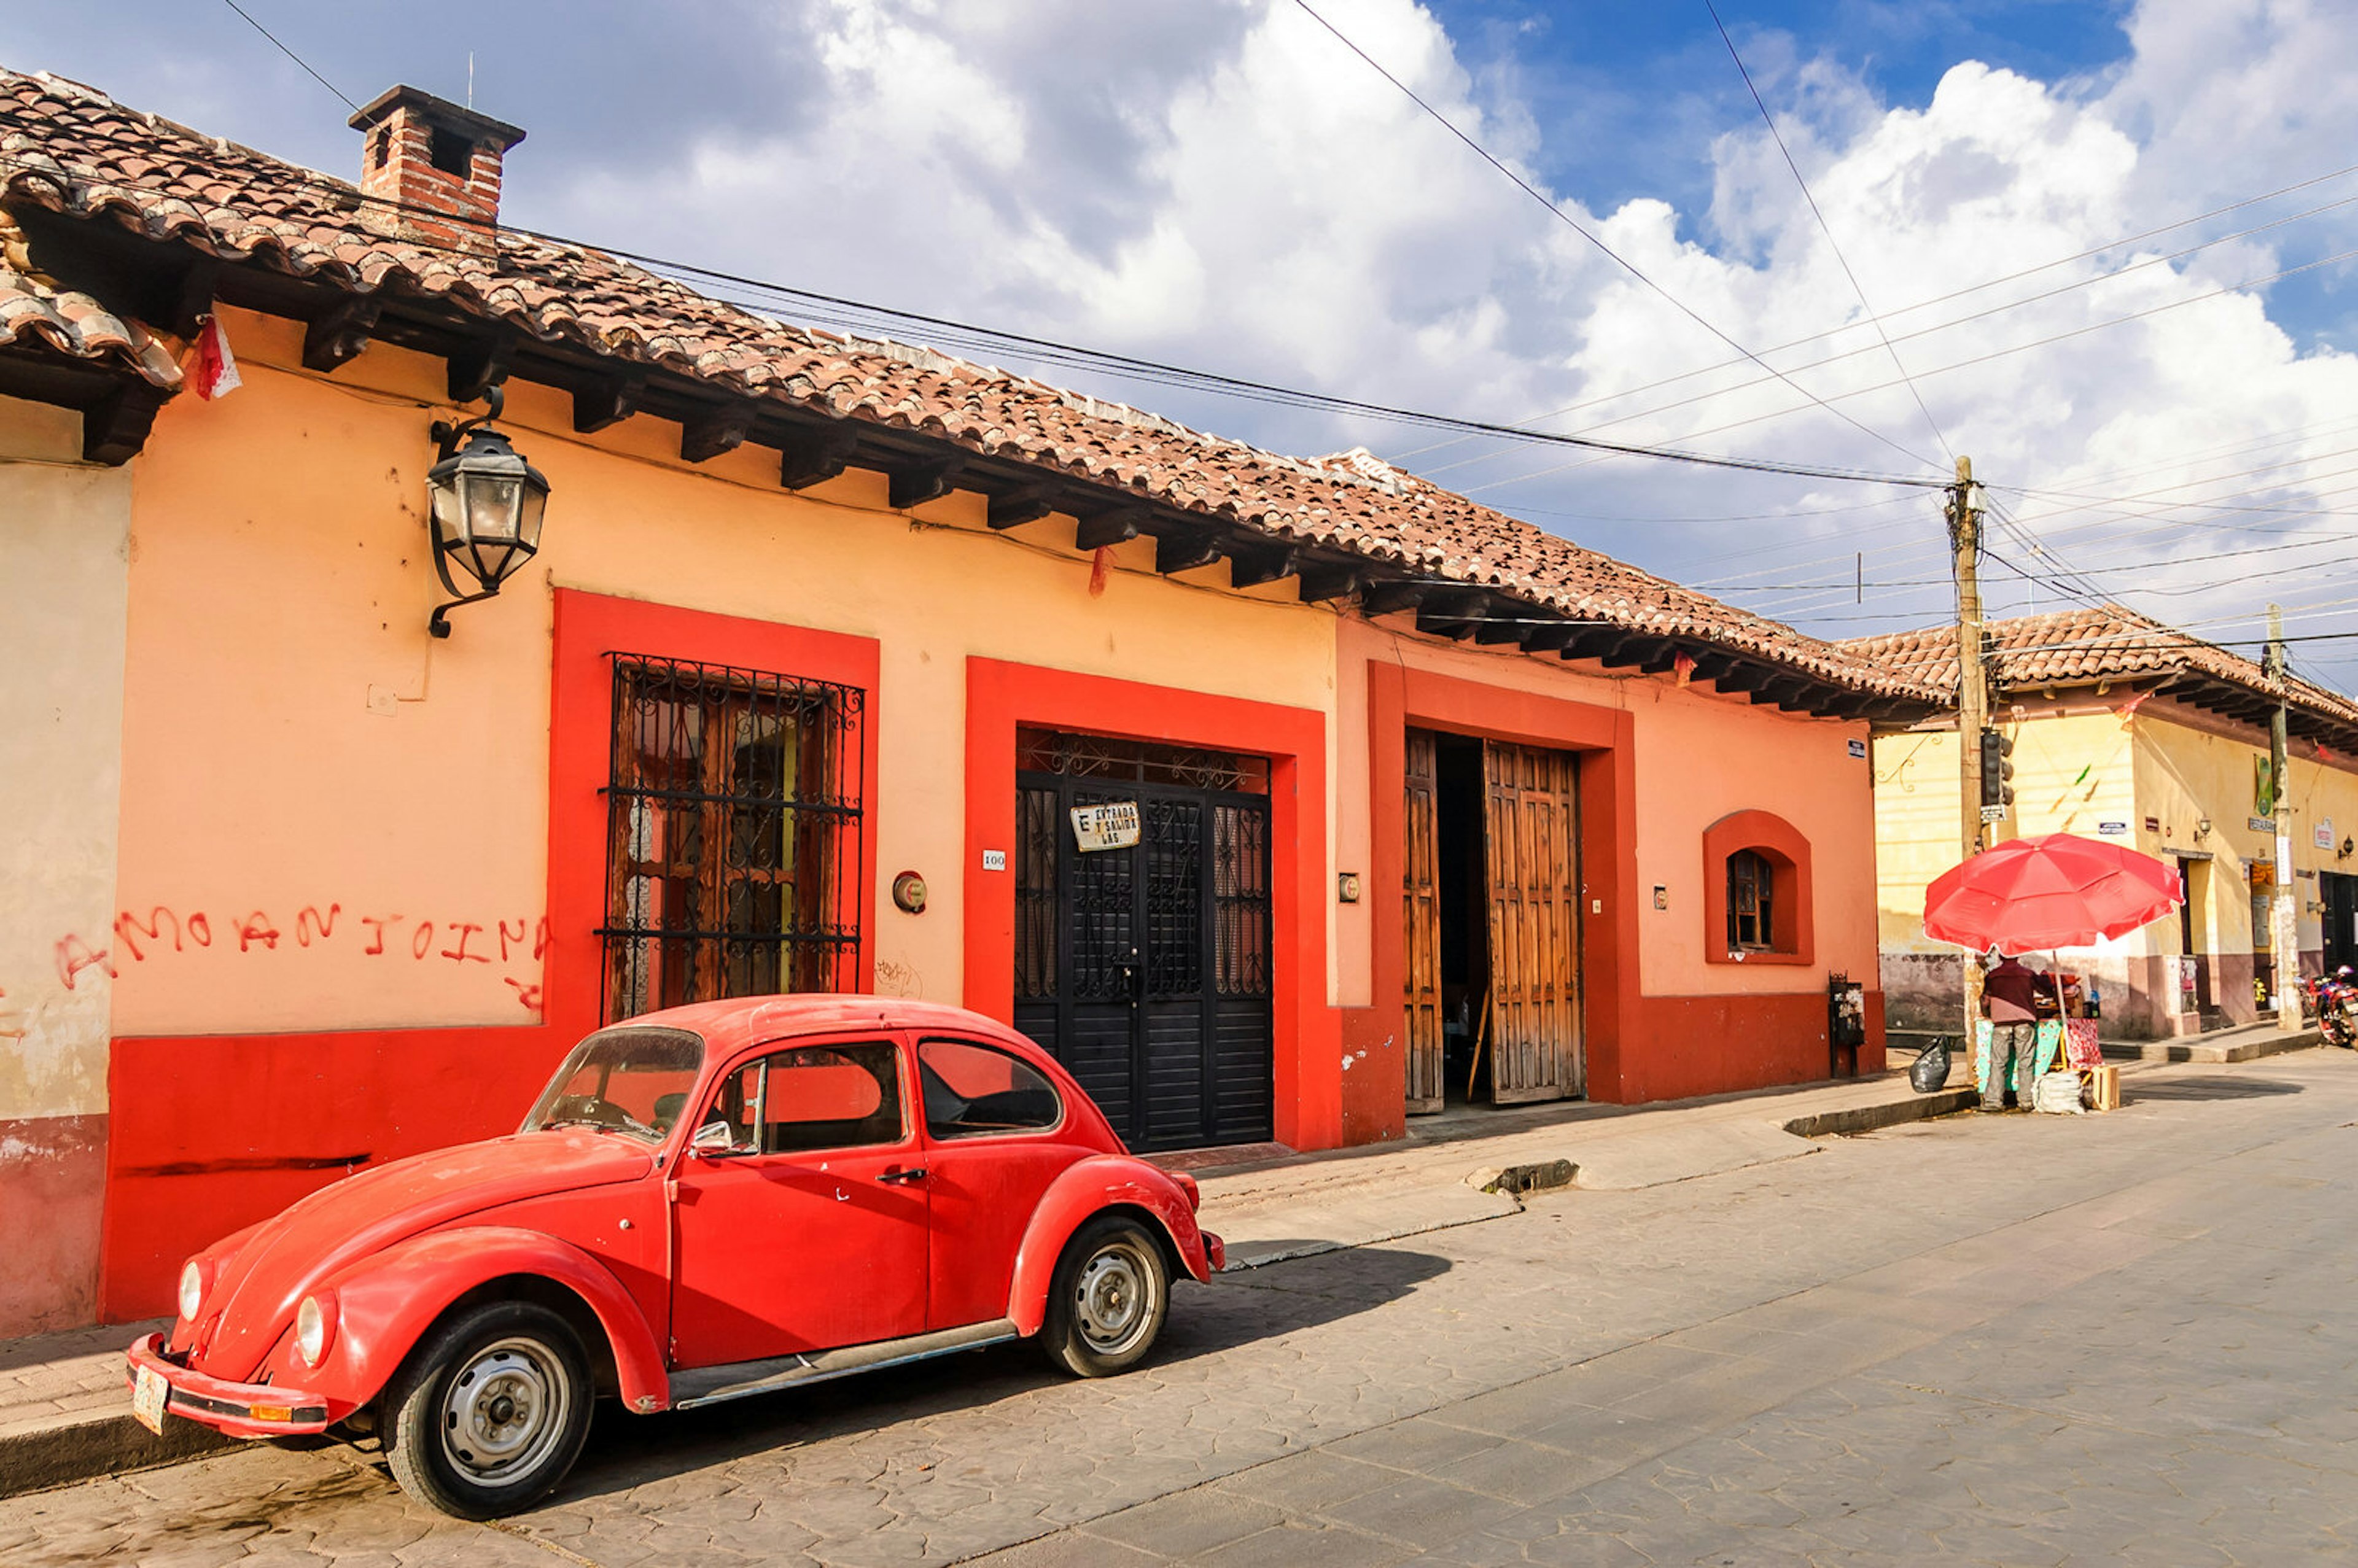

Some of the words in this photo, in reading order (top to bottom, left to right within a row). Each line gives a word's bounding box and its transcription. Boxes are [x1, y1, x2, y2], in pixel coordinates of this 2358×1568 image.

[1095, 806, 1135, 820] ENTRADA
[1079, 815, 1089, 831] E
[1095, 822, 1101, 833] Y
[1105, 818, 1137, 831] SALIDA
[985, 855, 1004, 866] 100
